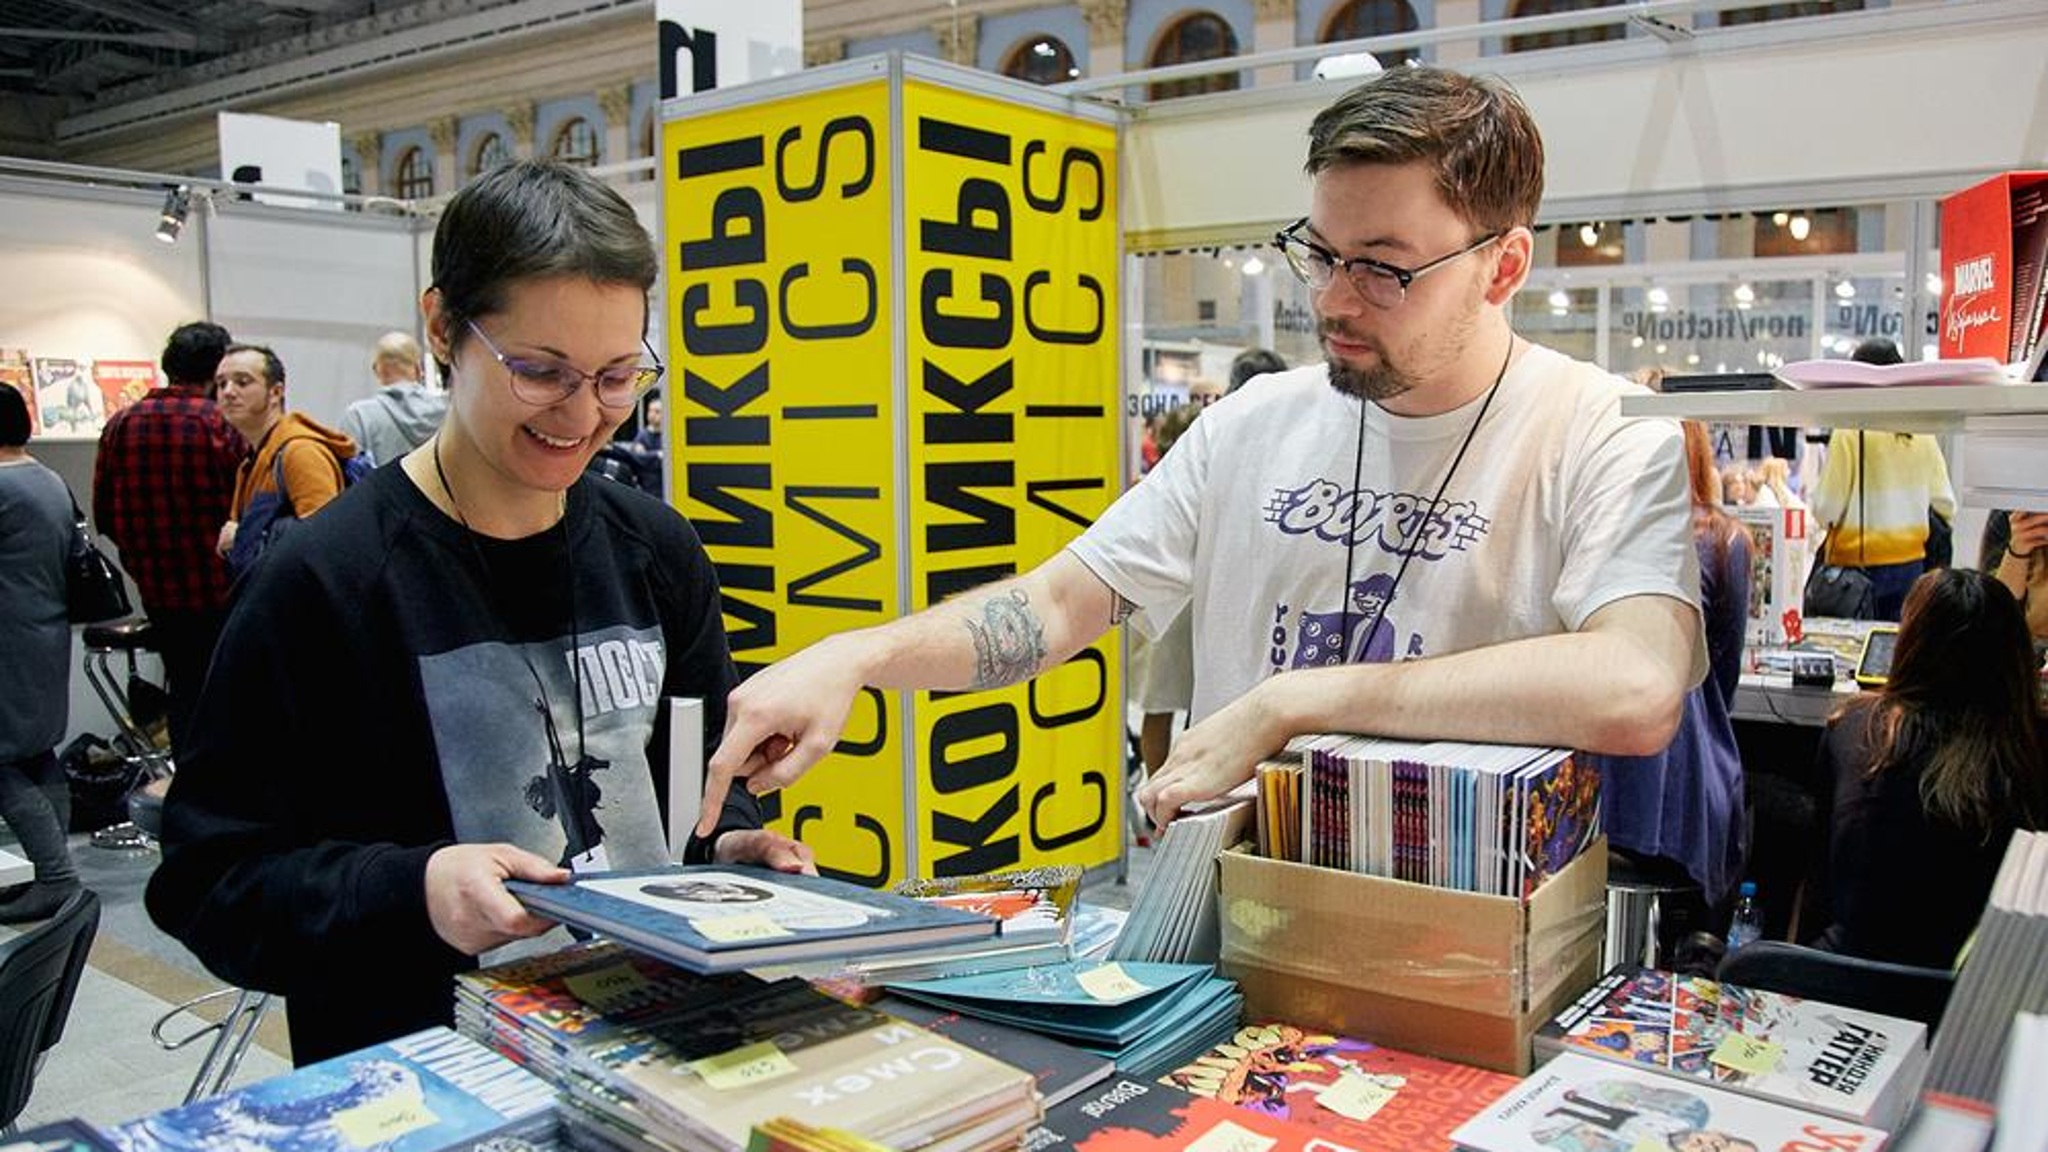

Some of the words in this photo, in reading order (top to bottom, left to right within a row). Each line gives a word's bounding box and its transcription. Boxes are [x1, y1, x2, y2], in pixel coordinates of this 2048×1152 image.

[1954, 257, 1994, 296] MARVEL
[794, 1046, 964, 1108] Смех
[1807, 1022, 1876, 1088] ГАТТЕР
